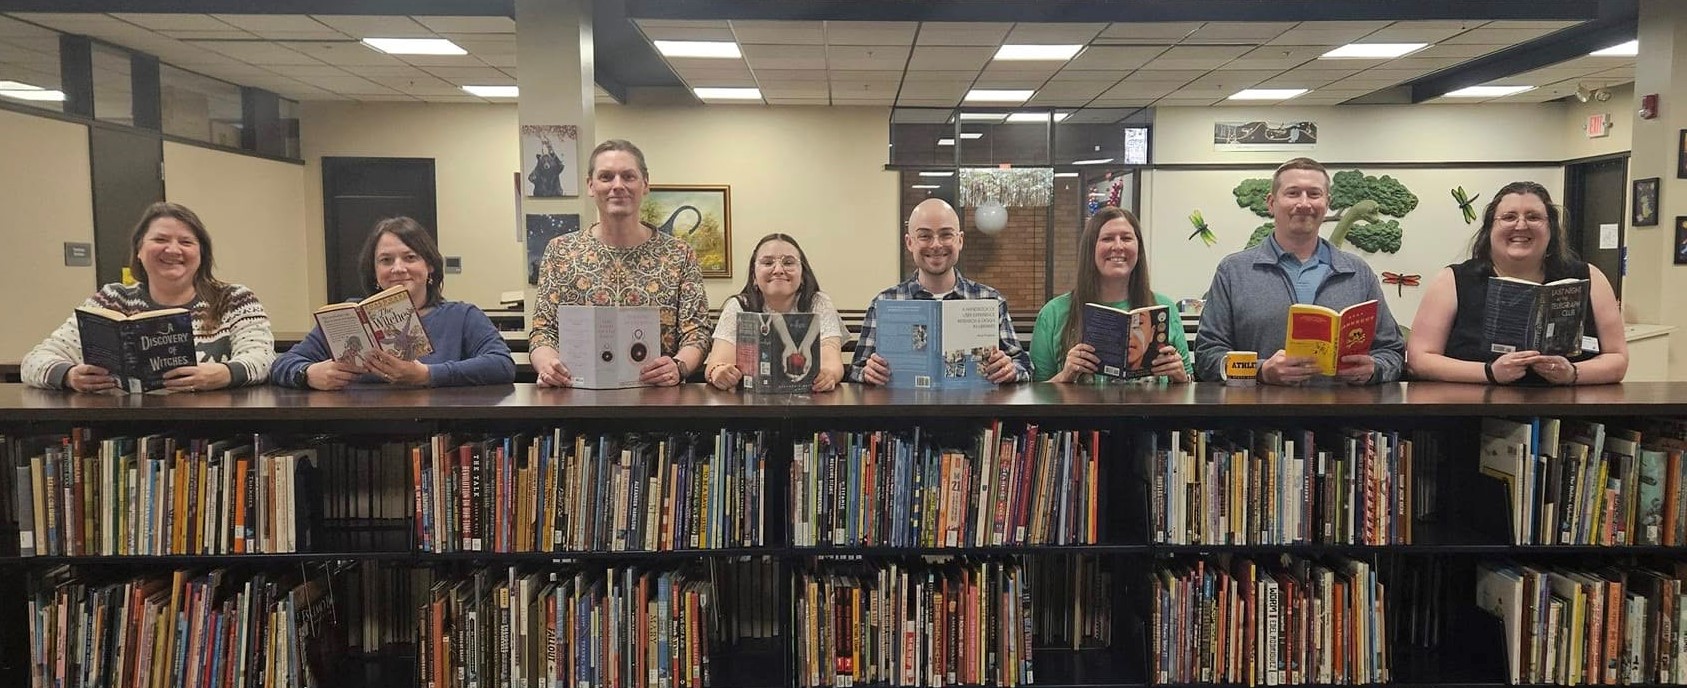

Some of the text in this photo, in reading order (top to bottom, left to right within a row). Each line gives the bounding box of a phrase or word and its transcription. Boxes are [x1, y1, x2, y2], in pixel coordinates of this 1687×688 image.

[380, 307, 394, 318] The
[1552, 302, 1580, 310] TELEGRAPH
[372, 308, 413, 328] Witches
[141, 333, 188, 350] DISCOVERY
[150, 356, 188, 371] WITCHES
[462, 466, 470, 498] REVOLUTION
[952, 481, 960, 491] 21
[1270, 587, 1278, 612] WORM
[846, 657, 850, 667] 2
